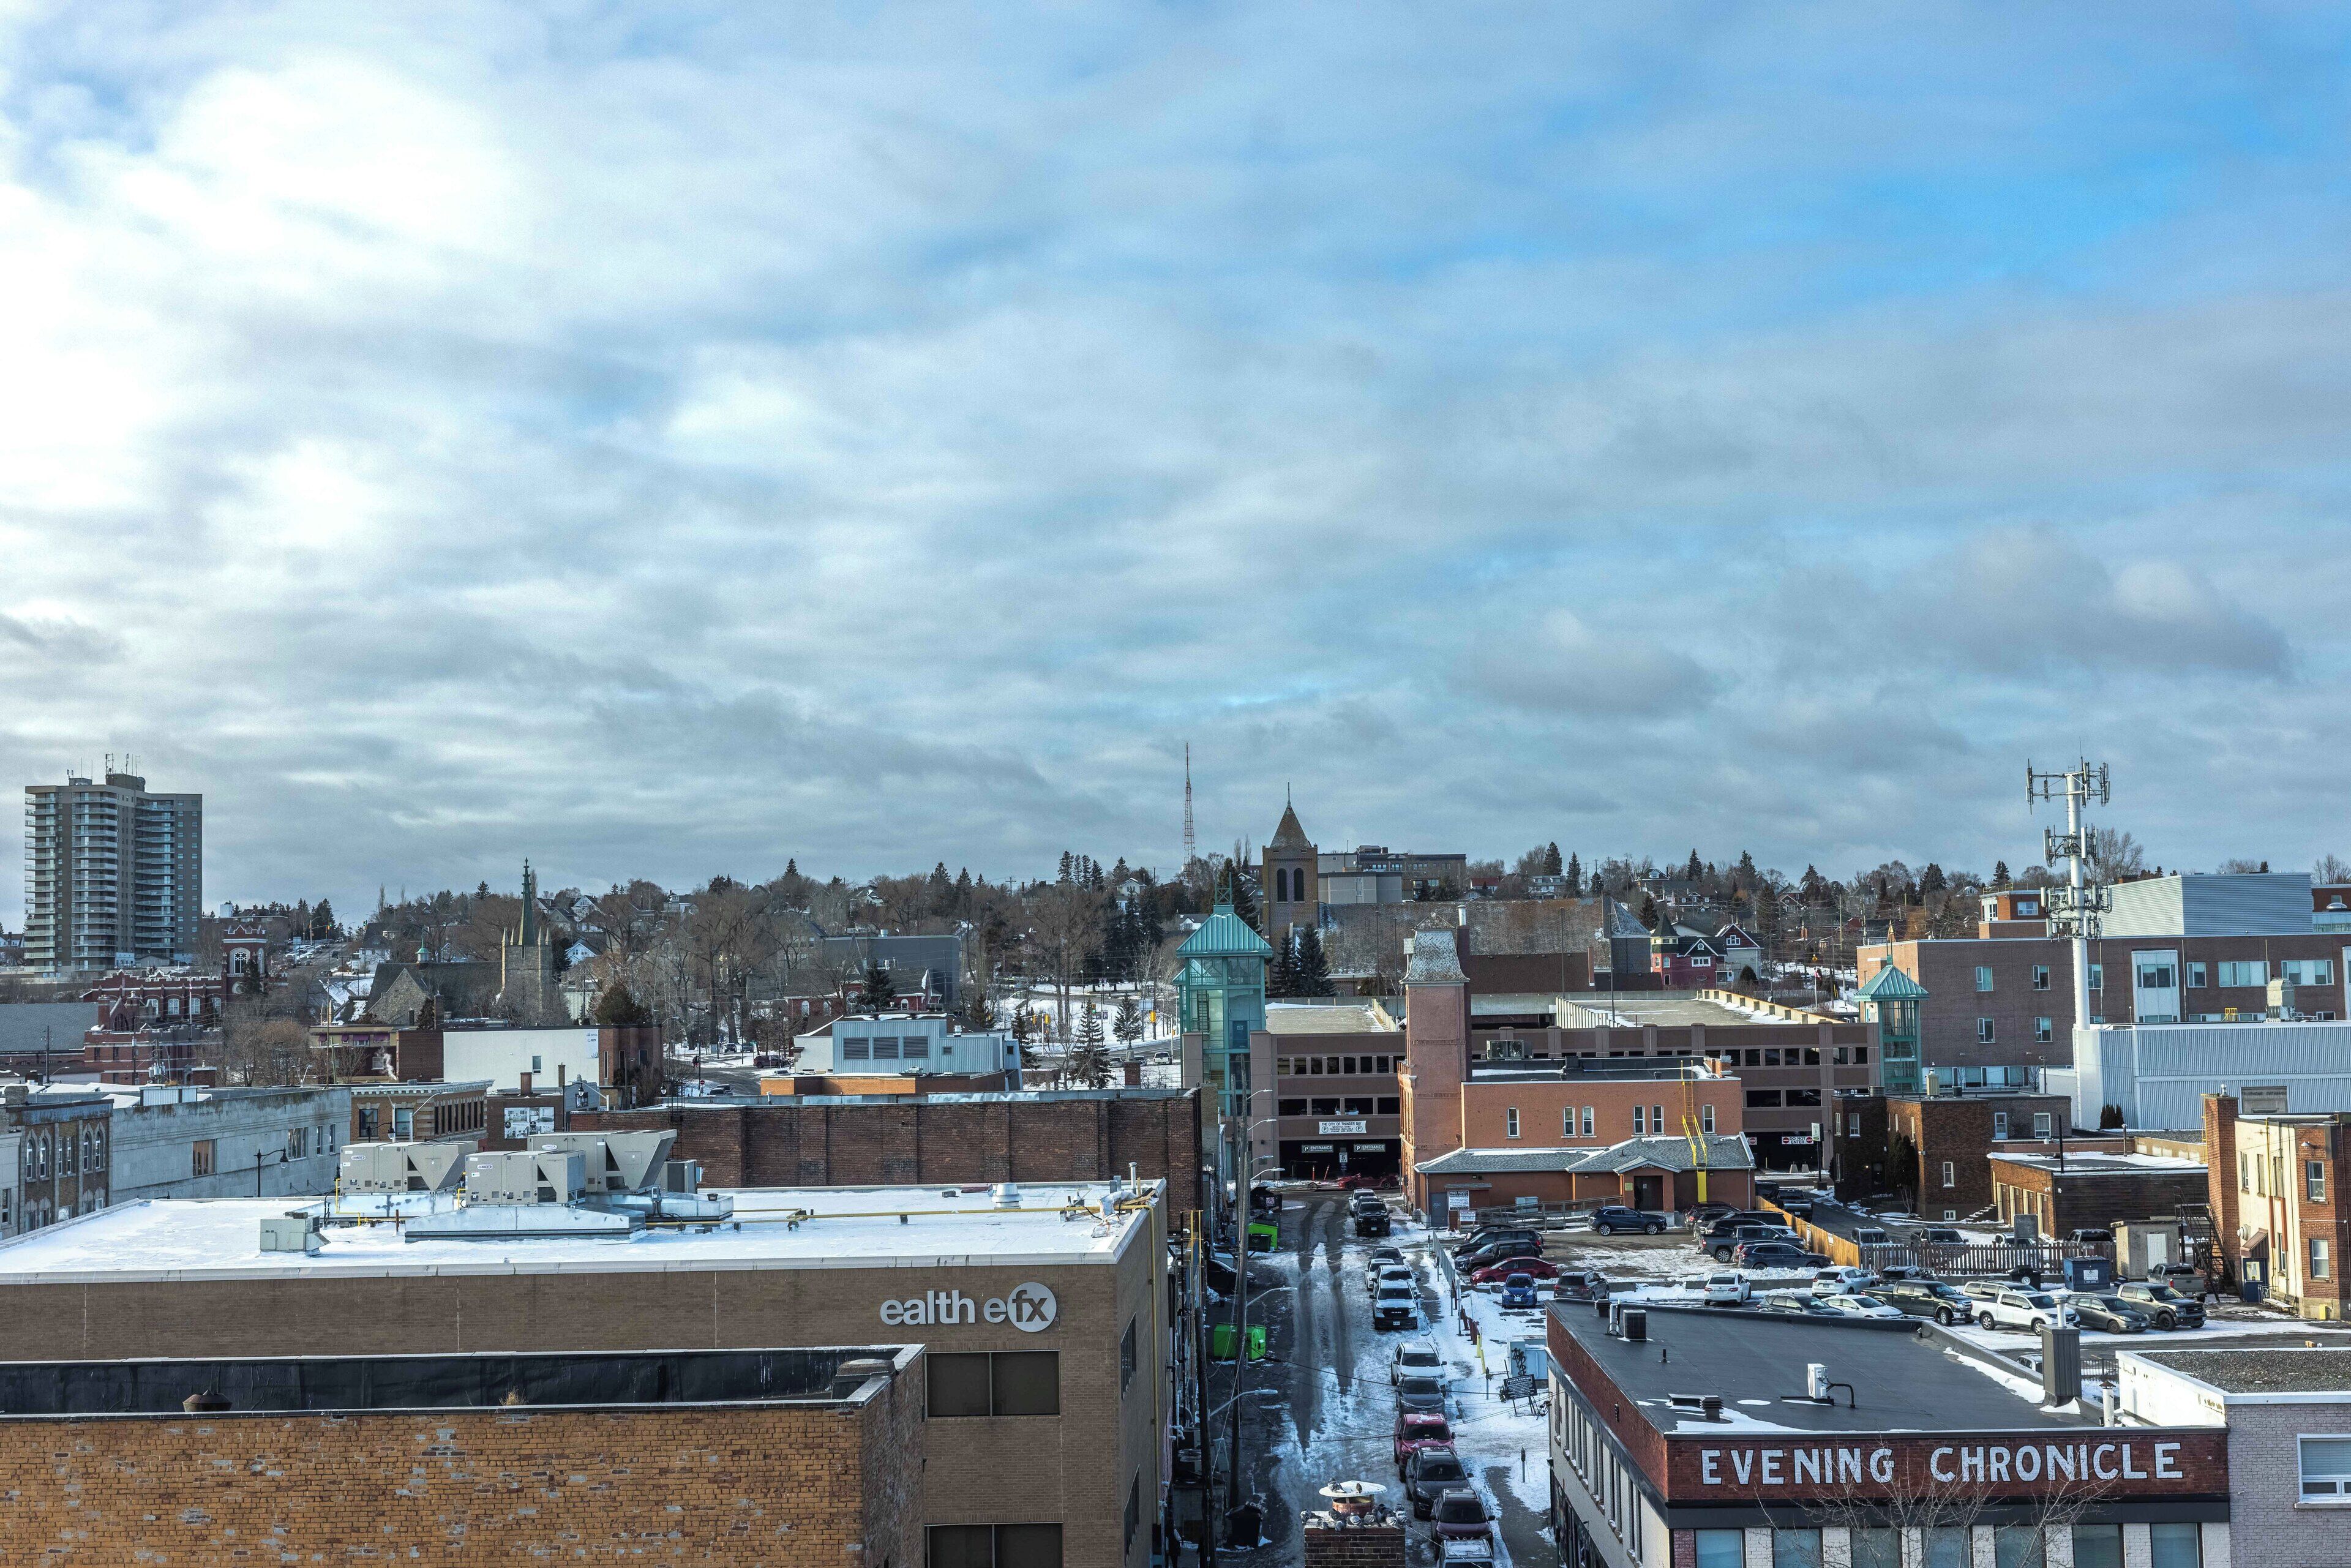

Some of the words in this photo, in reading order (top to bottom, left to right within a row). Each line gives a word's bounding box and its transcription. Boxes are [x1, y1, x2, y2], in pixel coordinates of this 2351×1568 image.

[880, 1289, 975, 1326] ealth
[1701, 1448, 1895, 1485] EVENING
[1929, 1442, 2184, 1482] CHRONICLE
